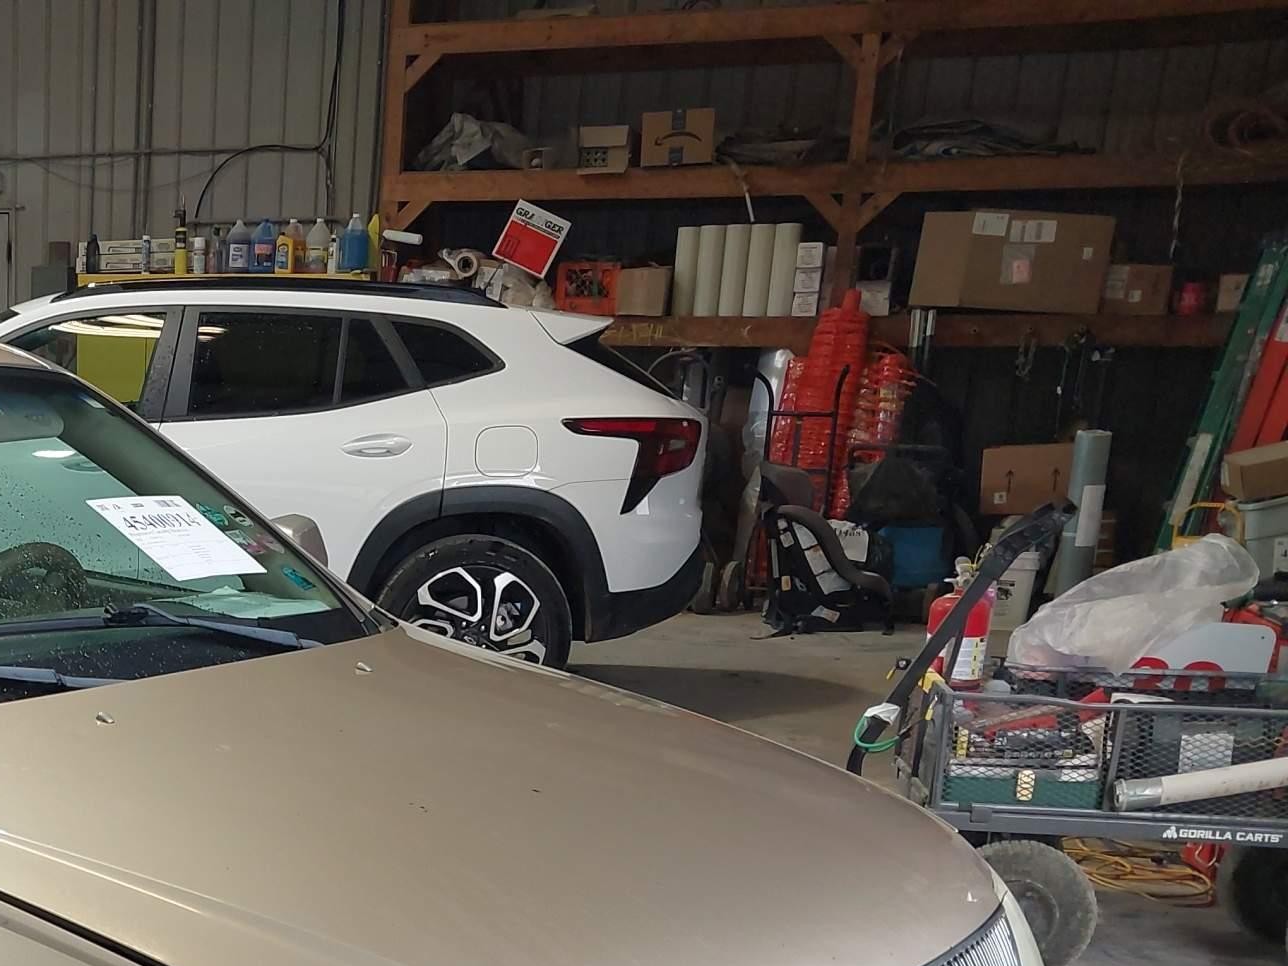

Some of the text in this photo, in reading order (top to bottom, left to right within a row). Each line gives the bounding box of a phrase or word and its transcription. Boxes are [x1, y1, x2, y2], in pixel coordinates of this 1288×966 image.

[122, 512, 202, 532] 45400914
[1179, 828, 1281, 843] GORILLA CARTS
